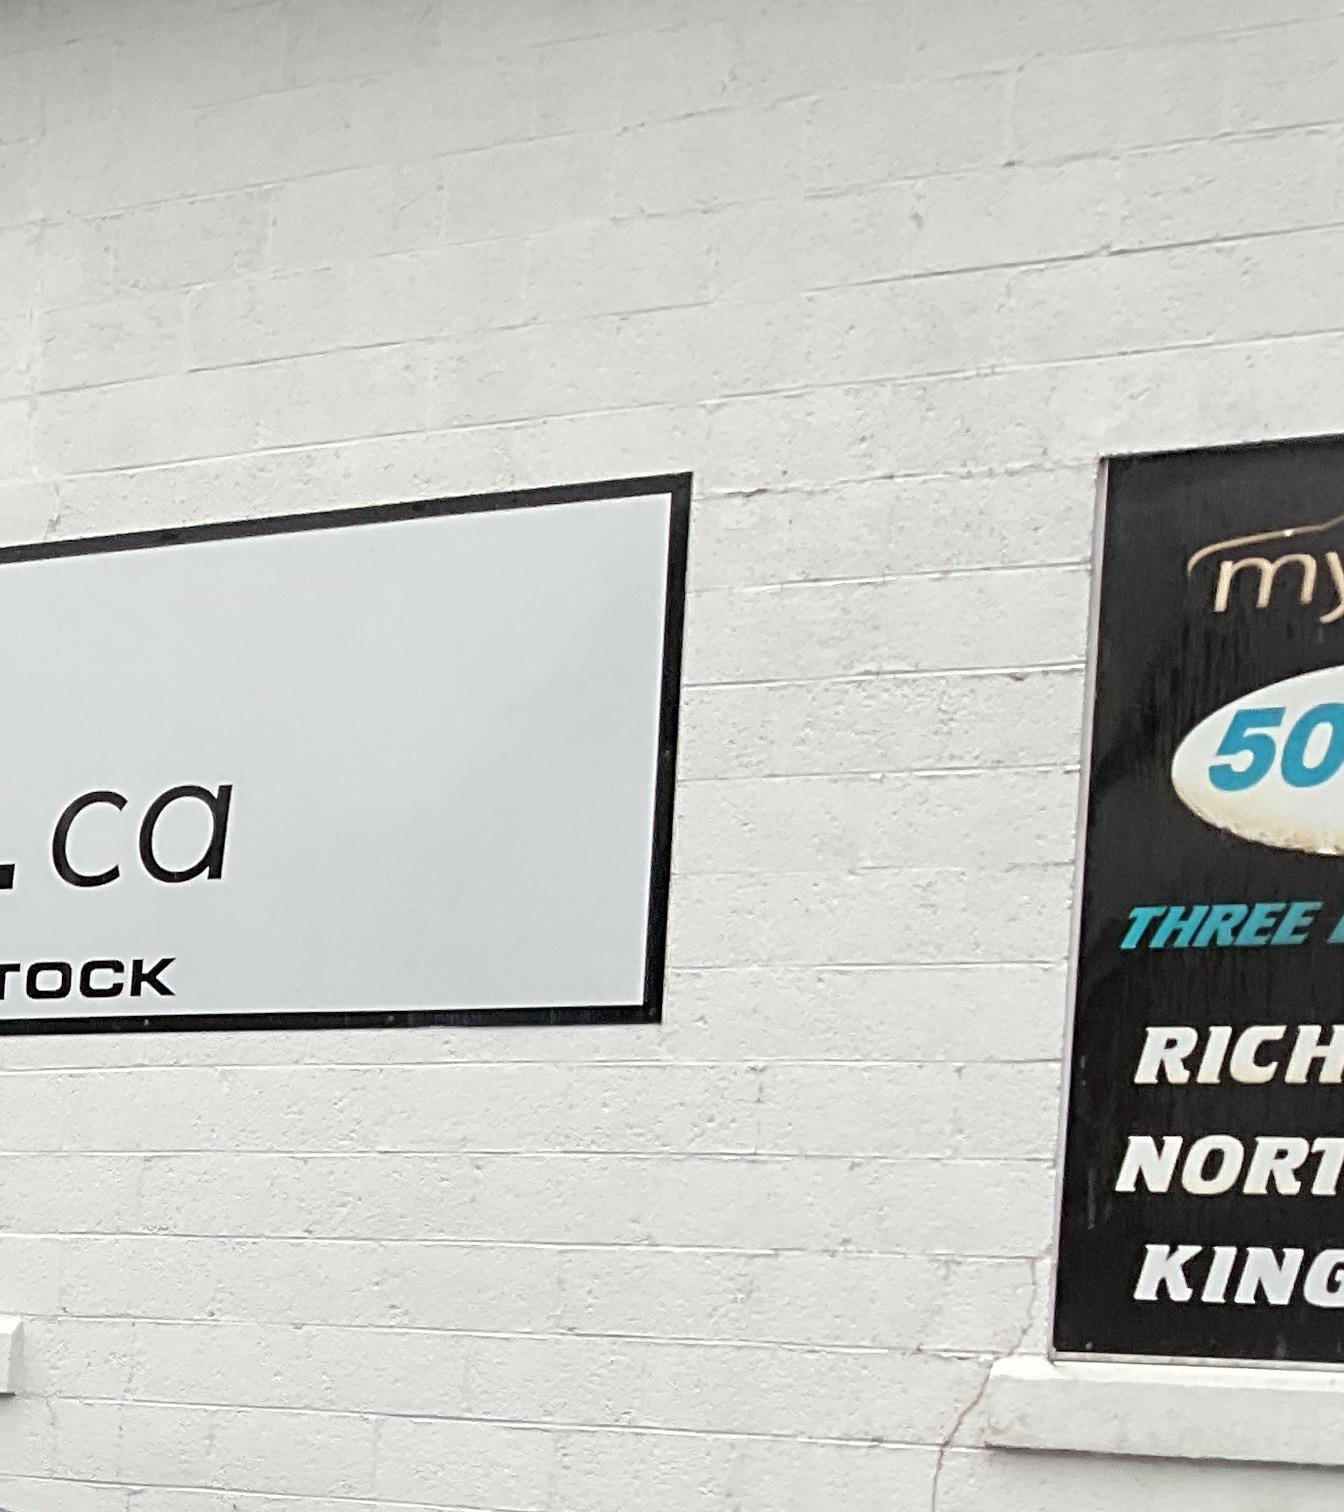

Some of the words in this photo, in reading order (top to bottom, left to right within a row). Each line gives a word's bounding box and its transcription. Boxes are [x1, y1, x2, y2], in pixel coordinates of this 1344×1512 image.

[1208, 702, 1344, 791] 50
[1119, 901, 1324, 949] THREE
[1133, 1024, 1344, 1084] RICH
